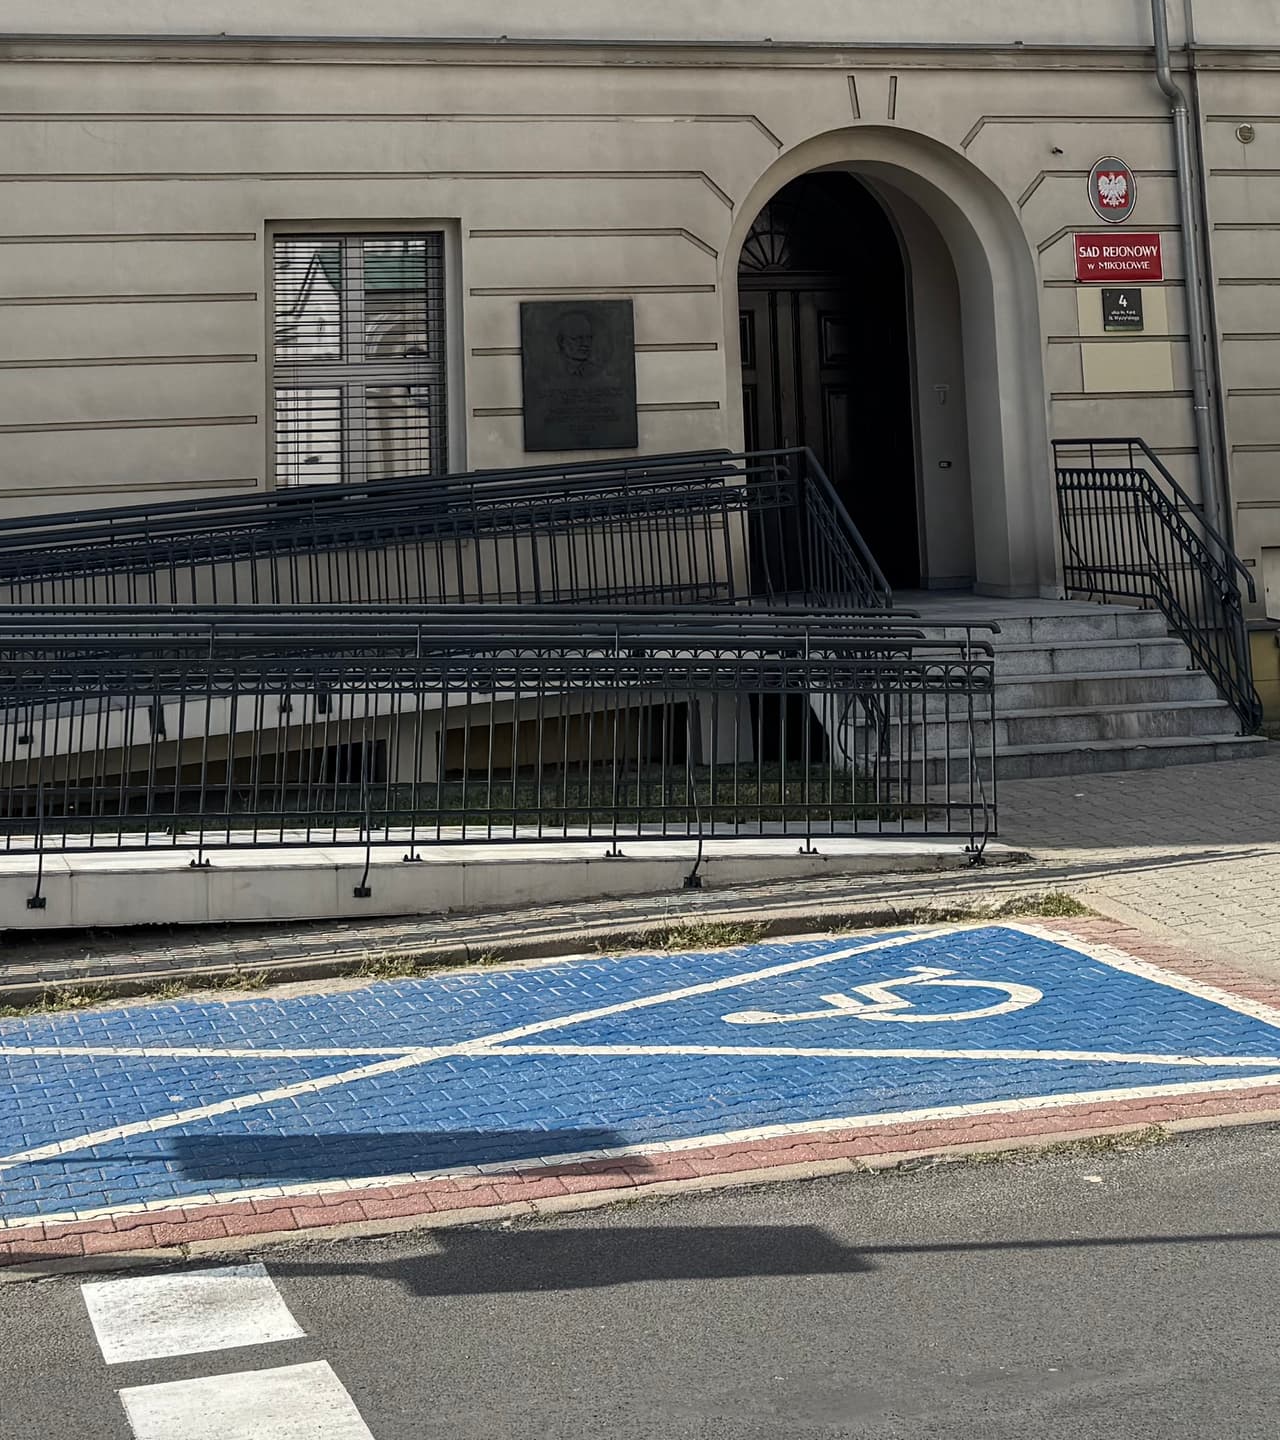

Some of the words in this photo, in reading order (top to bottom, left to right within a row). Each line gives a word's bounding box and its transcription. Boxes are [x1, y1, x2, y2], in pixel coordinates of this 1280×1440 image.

[1103, 245, 1158, 257] REJONOWY
[1098, 261, 1151, 270] MIKOŁOWIE
[1118, 294, 1128, 308] 4
